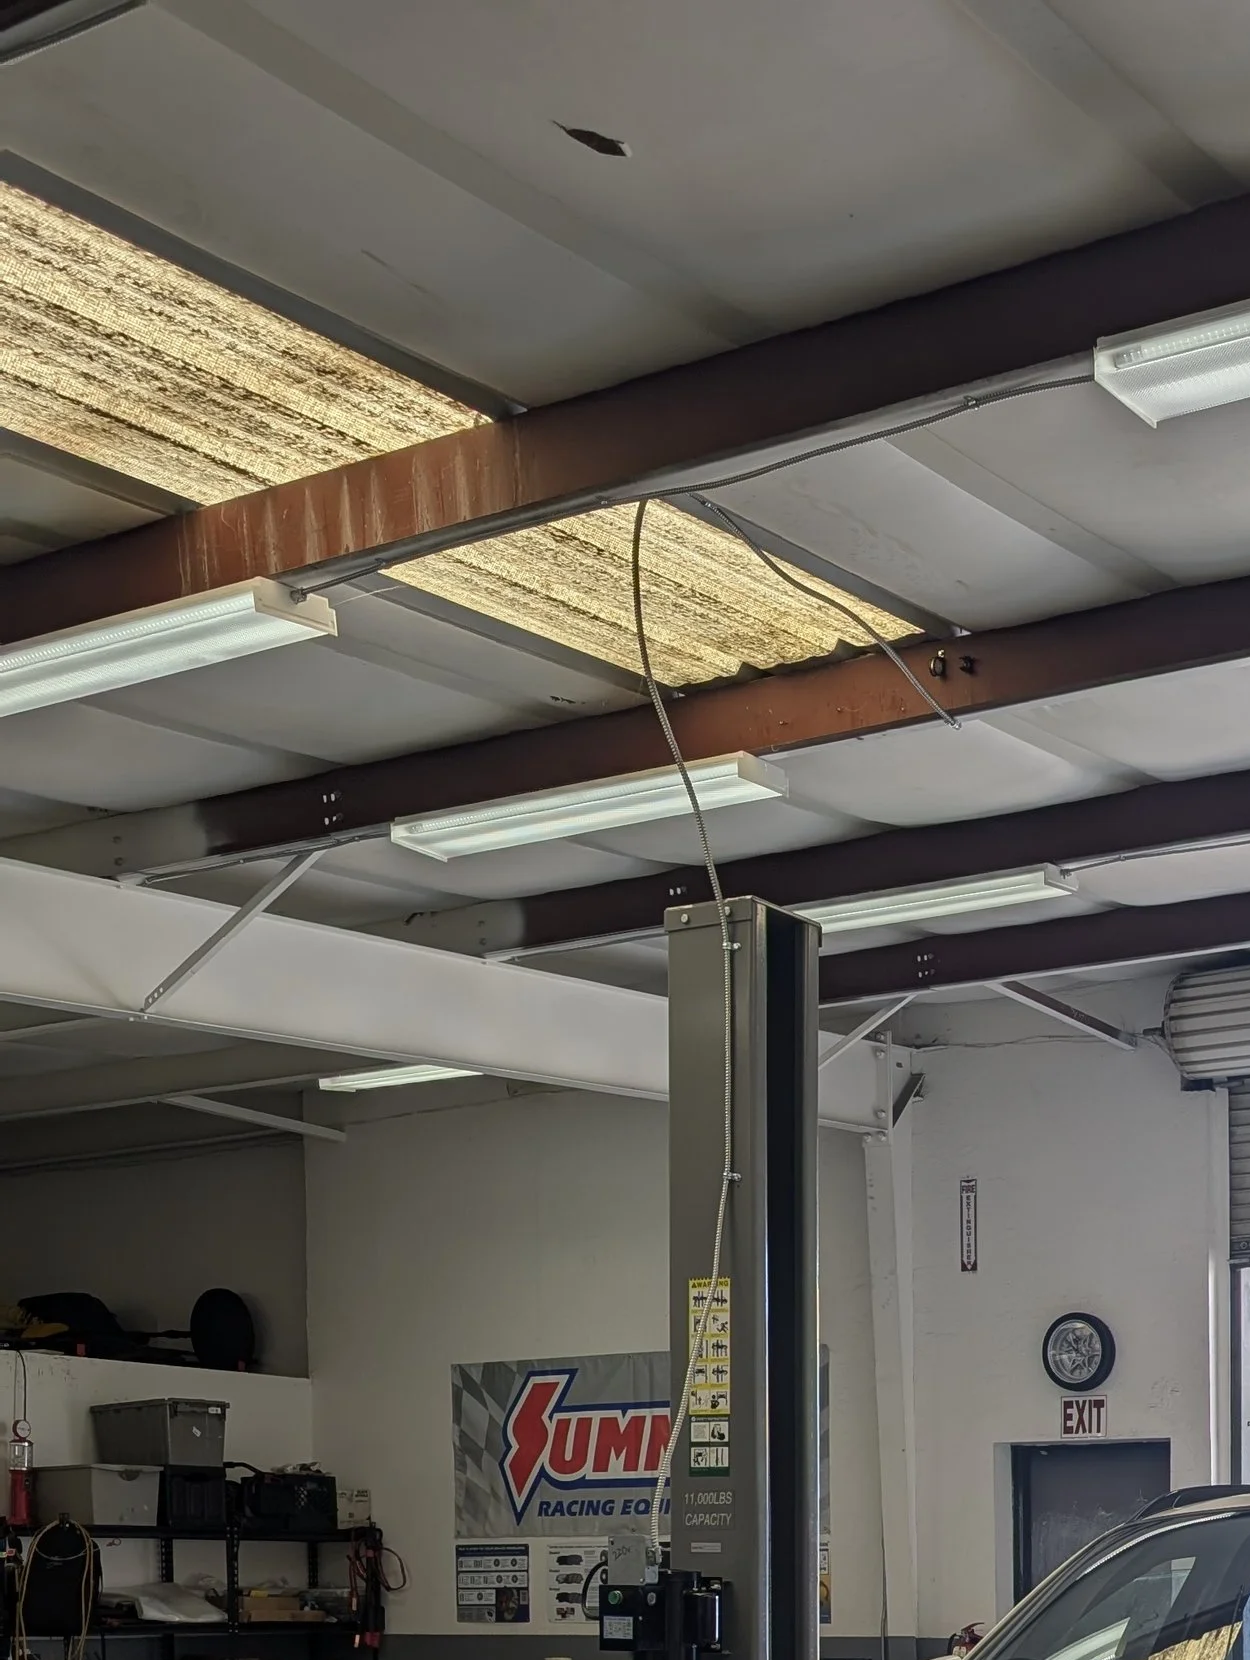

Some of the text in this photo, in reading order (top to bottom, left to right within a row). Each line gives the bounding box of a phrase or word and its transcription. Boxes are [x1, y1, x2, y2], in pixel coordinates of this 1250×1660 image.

[1062, 1399, 1105, 1435] EXIT
[684, 1491, 733, 1506] 11,000LBS
[537, 1500, 616, 1517] RACING
[685, 1512, 732, 1526] CAPACITY
